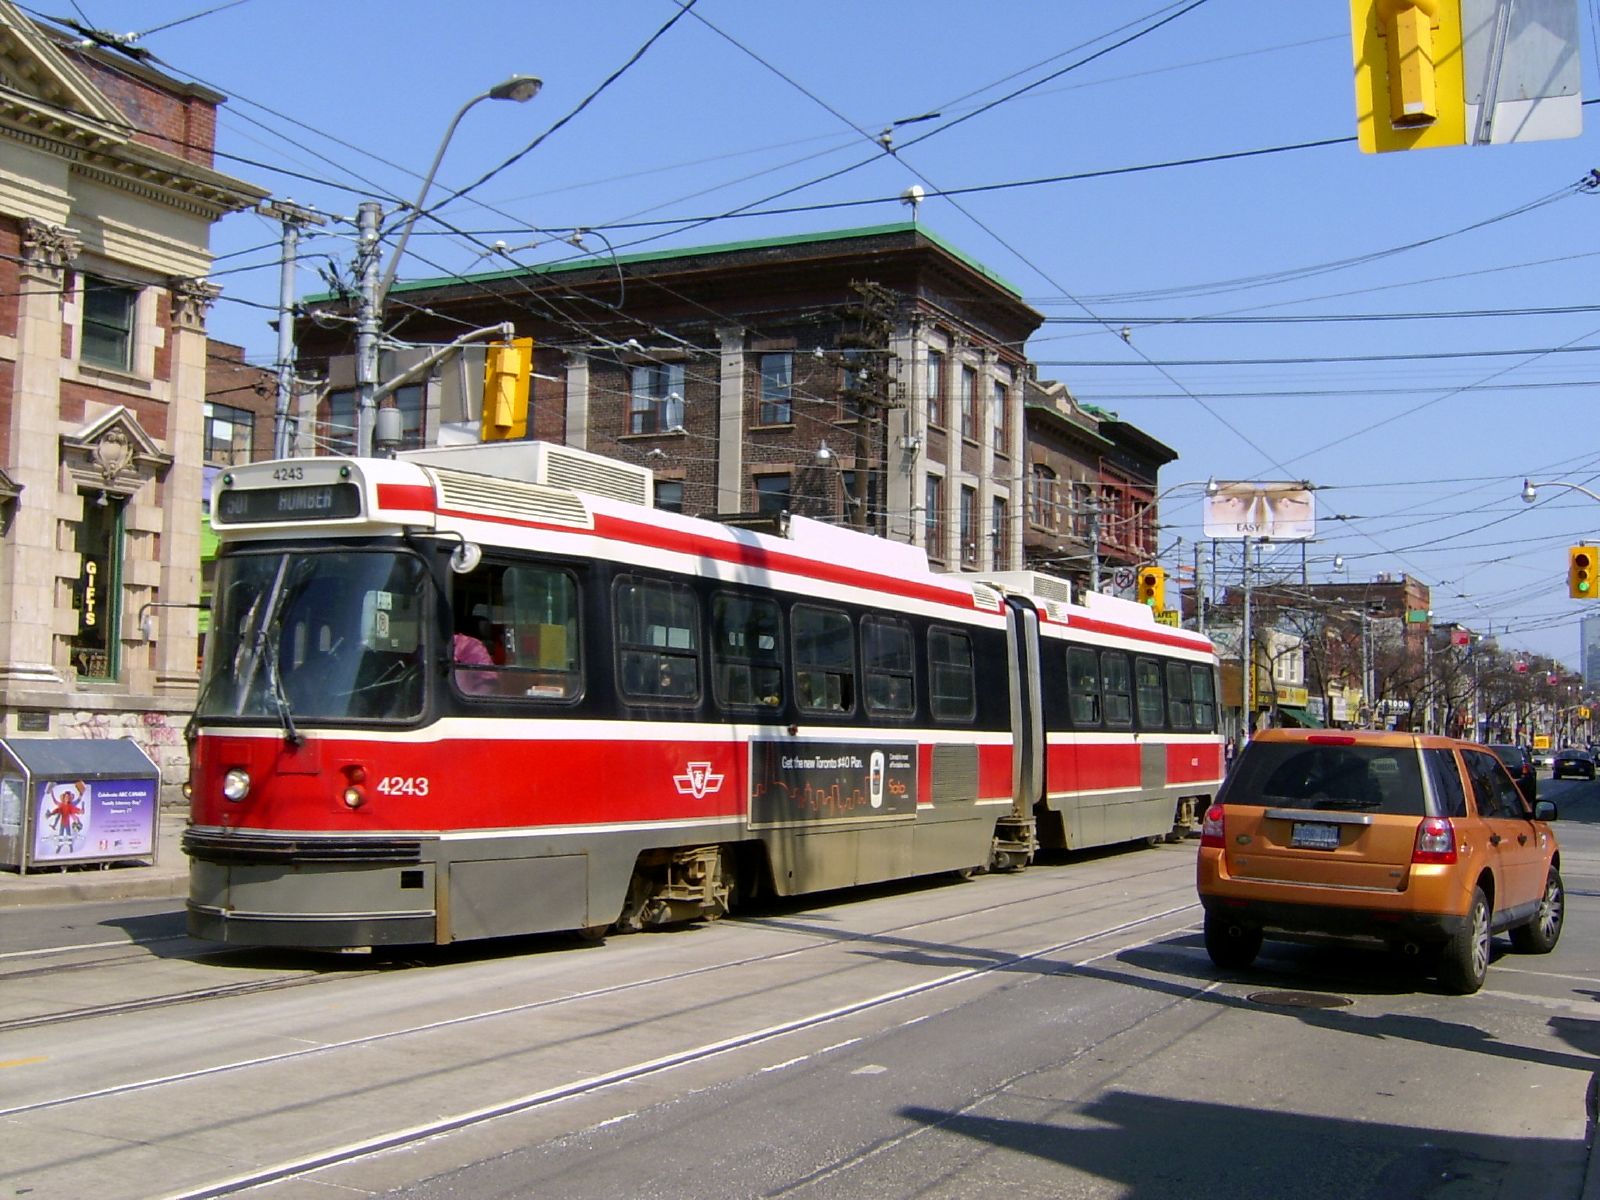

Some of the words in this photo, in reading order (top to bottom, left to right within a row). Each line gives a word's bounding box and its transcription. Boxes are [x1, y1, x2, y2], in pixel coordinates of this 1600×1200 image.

[273, 467, 304, 481] 4243
[277, 487, 332, 511] HUMBER
[1236, 523, 1261, 533] EASY
[85, 561, 97, 626] GIFTS
[781, 755, 793, 769] Get
[794, 755, 803, 769] the
[803, 759, 816, 769] new
[815, 755, 837, 769] Toronto
[837, 755, 850, 769] $40
[850, 755, 864, 769] Plan.
[376, 776, 429, 797] 4243
